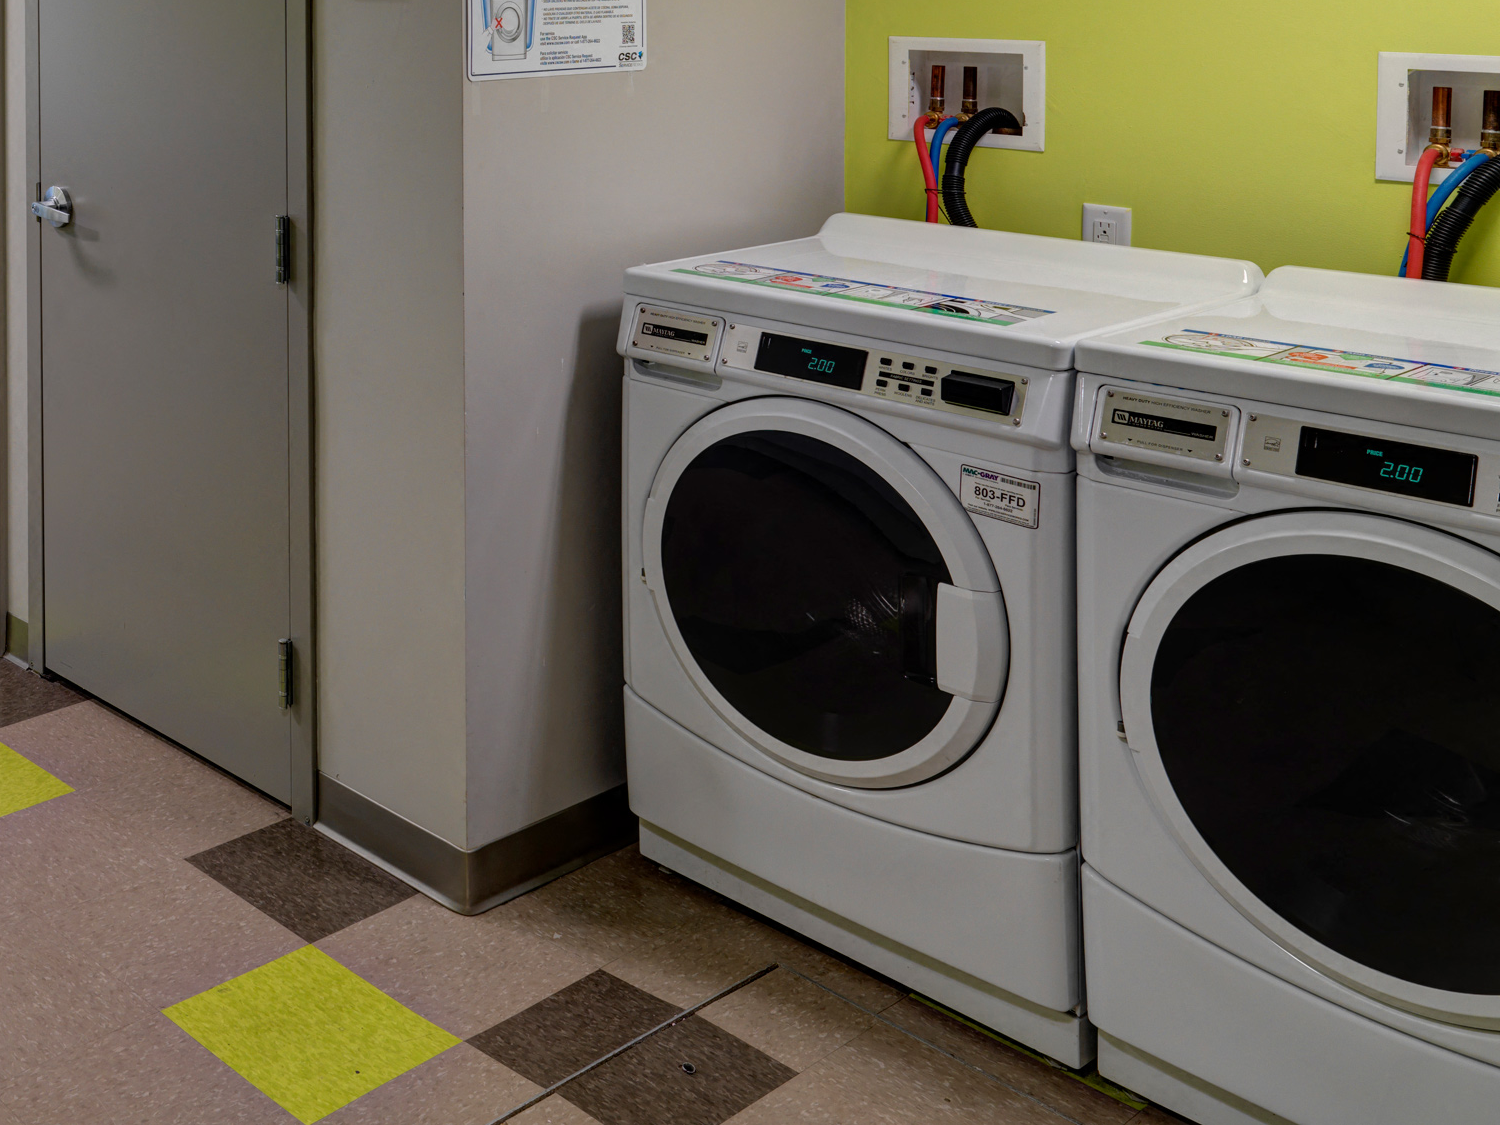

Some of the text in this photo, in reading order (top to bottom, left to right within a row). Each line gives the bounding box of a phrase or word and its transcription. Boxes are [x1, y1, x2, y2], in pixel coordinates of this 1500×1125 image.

[619, 52, 637, 61] CSC
[653, 328, 675, 336] MAYTAG
[808, 358, 835, 373] 2.00
[1129, 416, 1164, 428] MAYTAG
[1367, 449, 1383, 457] PRICE
[963, 467, 999, 481] MAC-GRAY
[1380, 462, 1423, 482] 2.00
[974, 486, 1025, 507] 803-FFD
